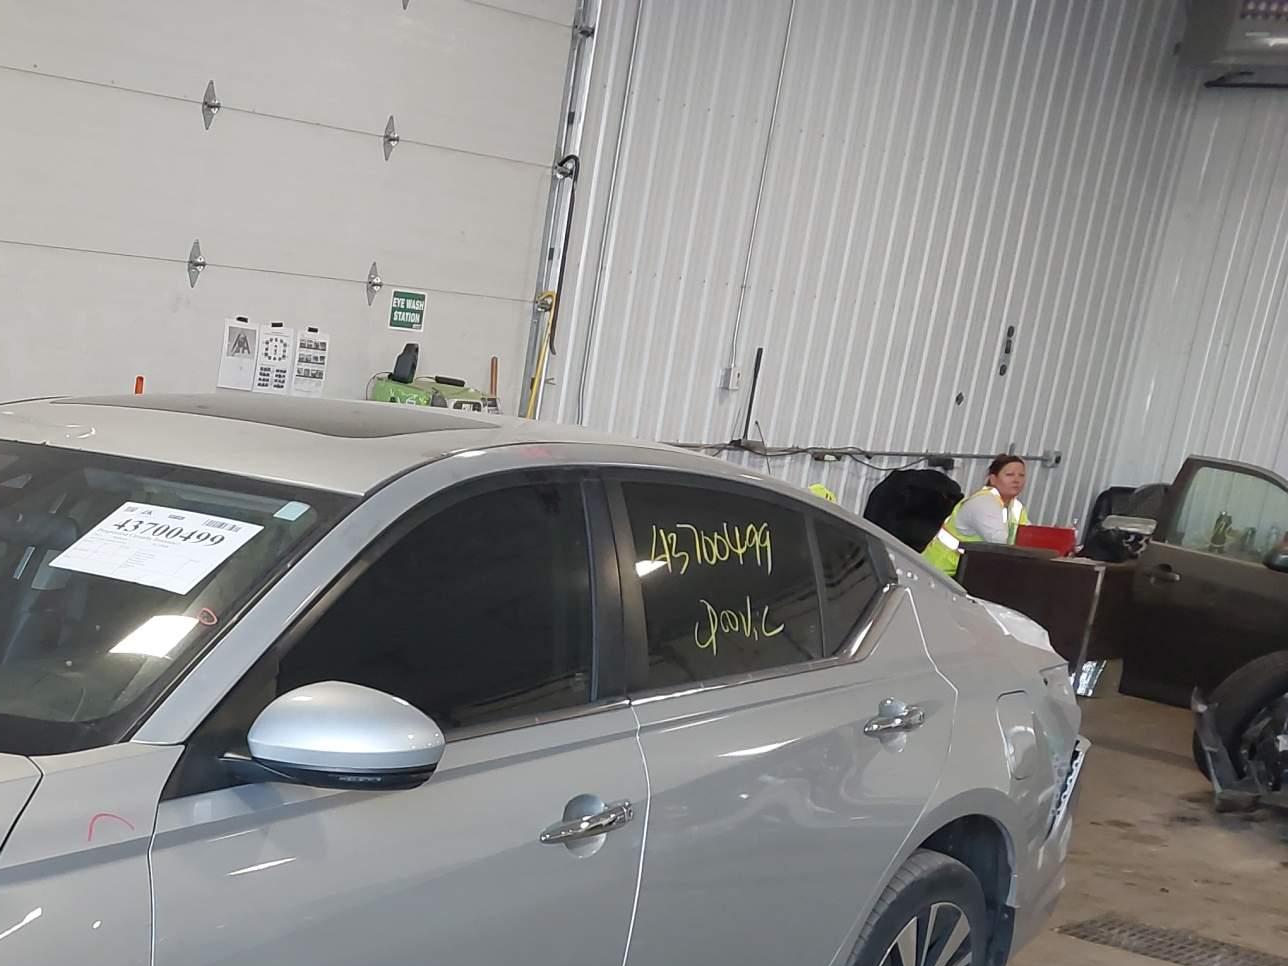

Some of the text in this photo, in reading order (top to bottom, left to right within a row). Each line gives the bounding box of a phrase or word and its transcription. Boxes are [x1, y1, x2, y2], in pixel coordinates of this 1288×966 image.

[392, 297, 425, 312] EYE WASH
[393, 310, 421, 325] STATION
[113, 517, 226, 548] 43700499
[650, 521, 774, 577] 43700499
